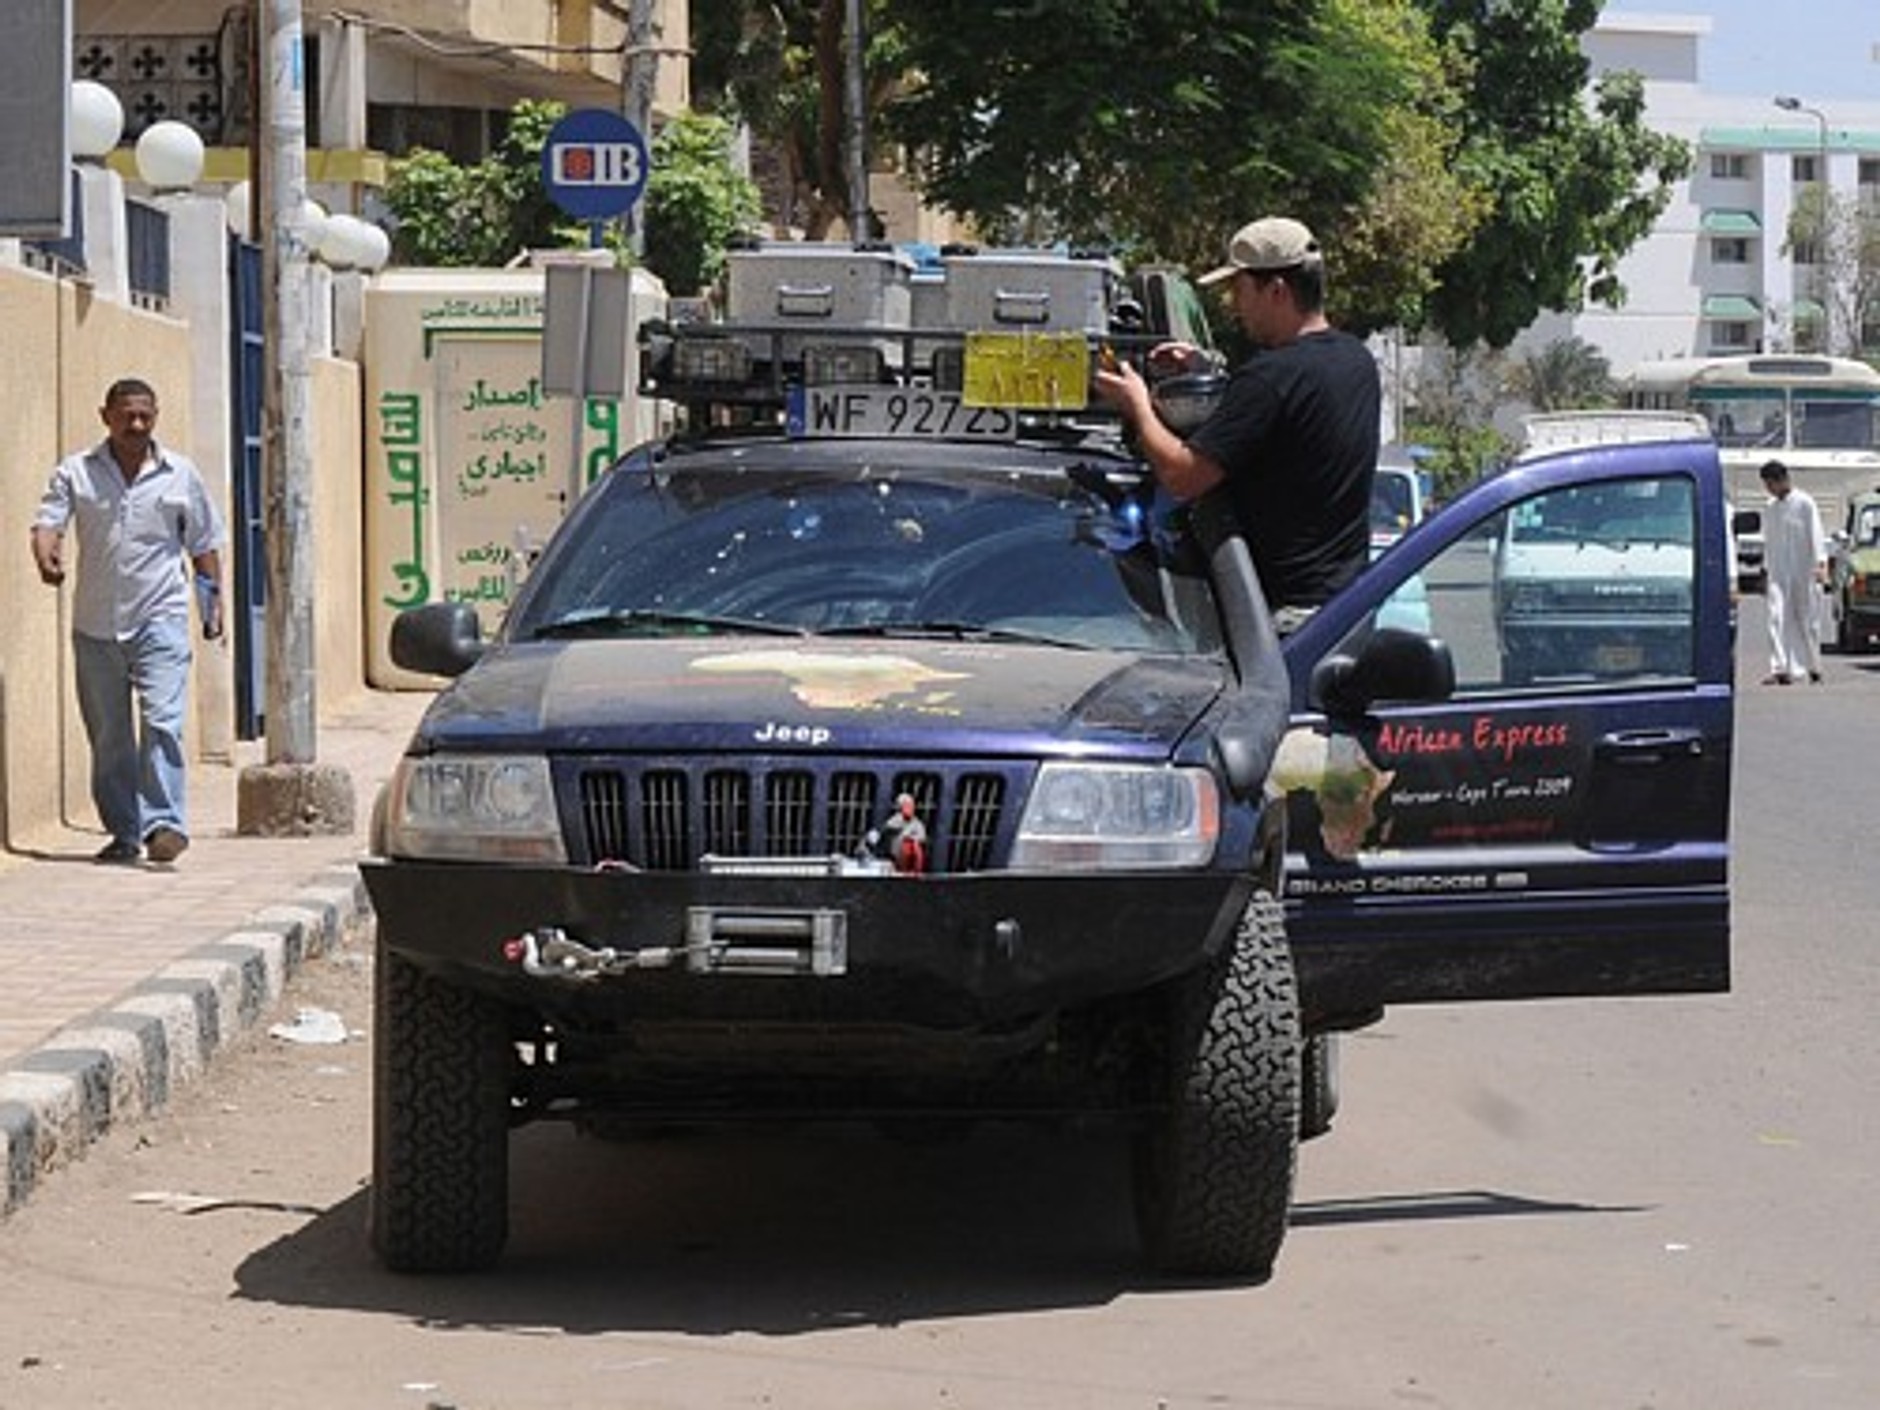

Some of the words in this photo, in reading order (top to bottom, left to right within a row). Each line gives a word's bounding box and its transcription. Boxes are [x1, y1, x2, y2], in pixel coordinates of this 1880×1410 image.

[552, 143, 640, 186] CIB
[812, 392, 869, 432] WF
[754, 722, 831, 746] Jeep
[1377, 723, 1463, 754] African
[1474, 717, 1569, 762] Express
